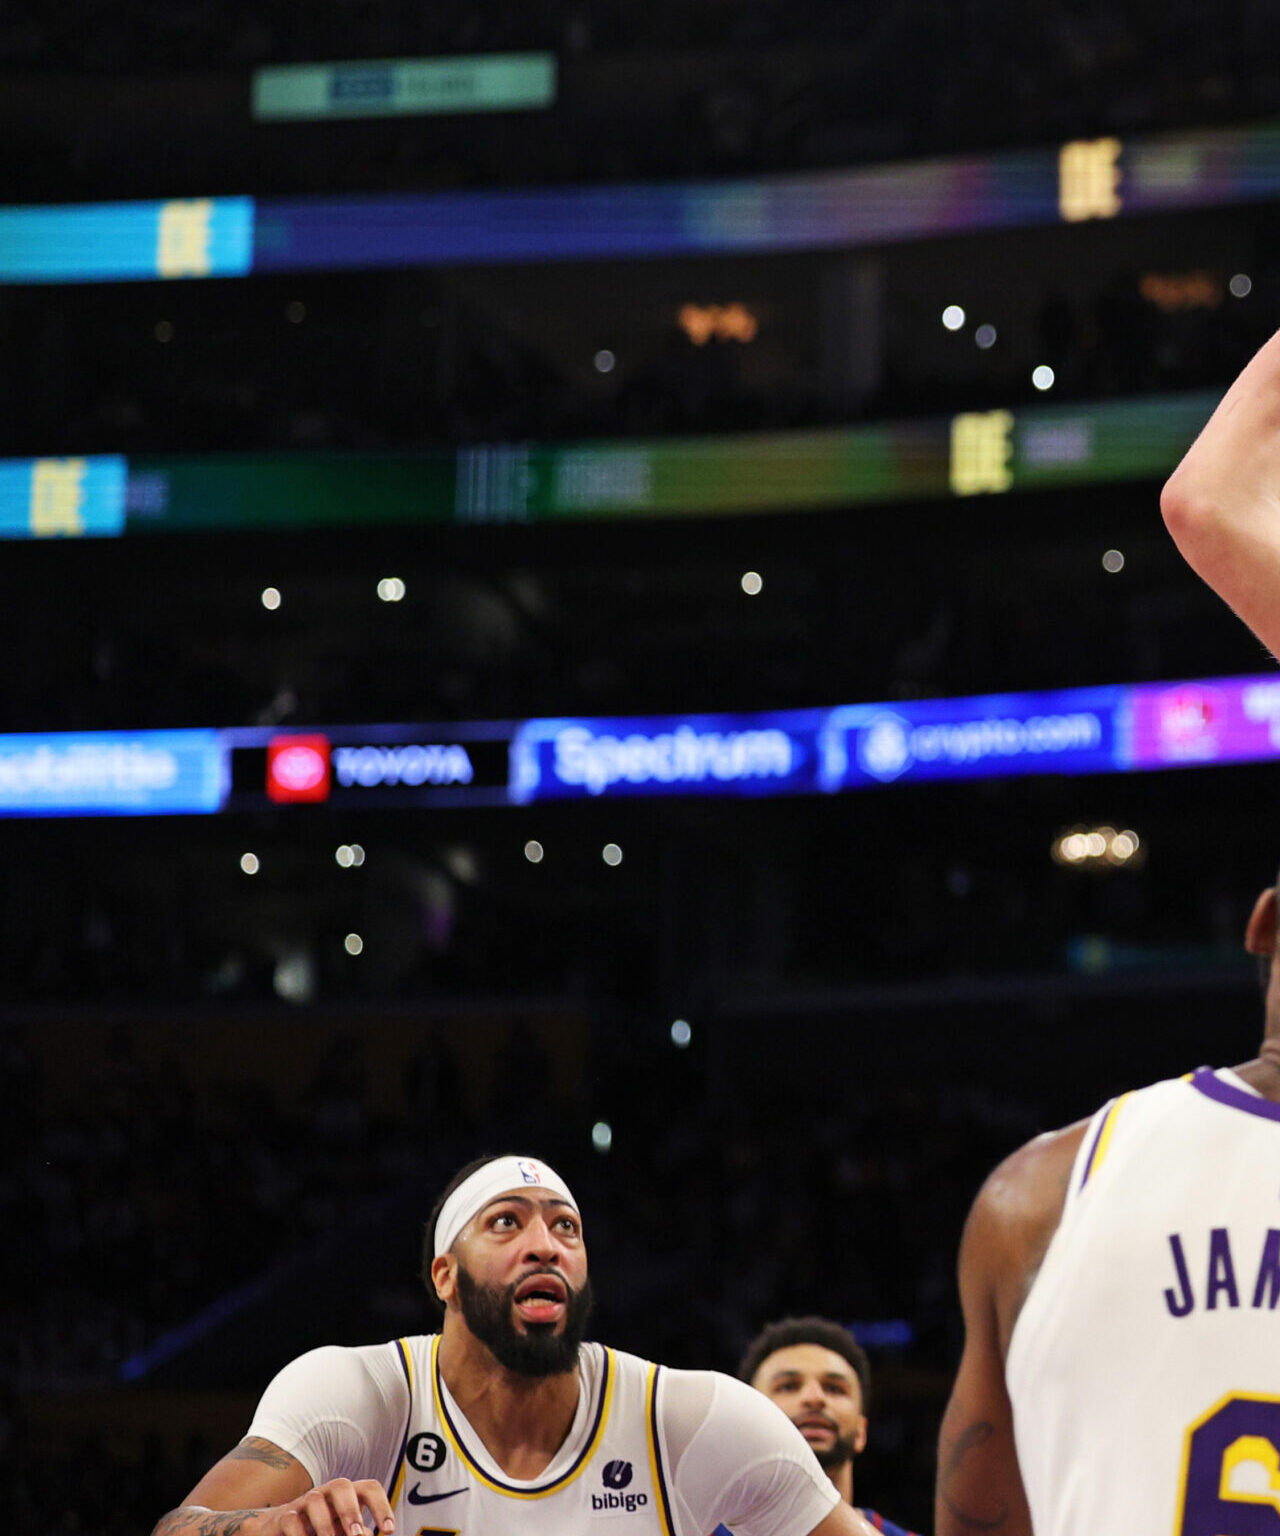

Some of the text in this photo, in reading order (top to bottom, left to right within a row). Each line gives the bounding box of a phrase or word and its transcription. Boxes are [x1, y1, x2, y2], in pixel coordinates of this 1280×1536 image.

[333, 744, 473, 786] TOYOTA
[553, 724, 792, 795] Spectrum
[415, 1437, 438, 1468] 6
[591, 1491, 648, 1512] bibigo
